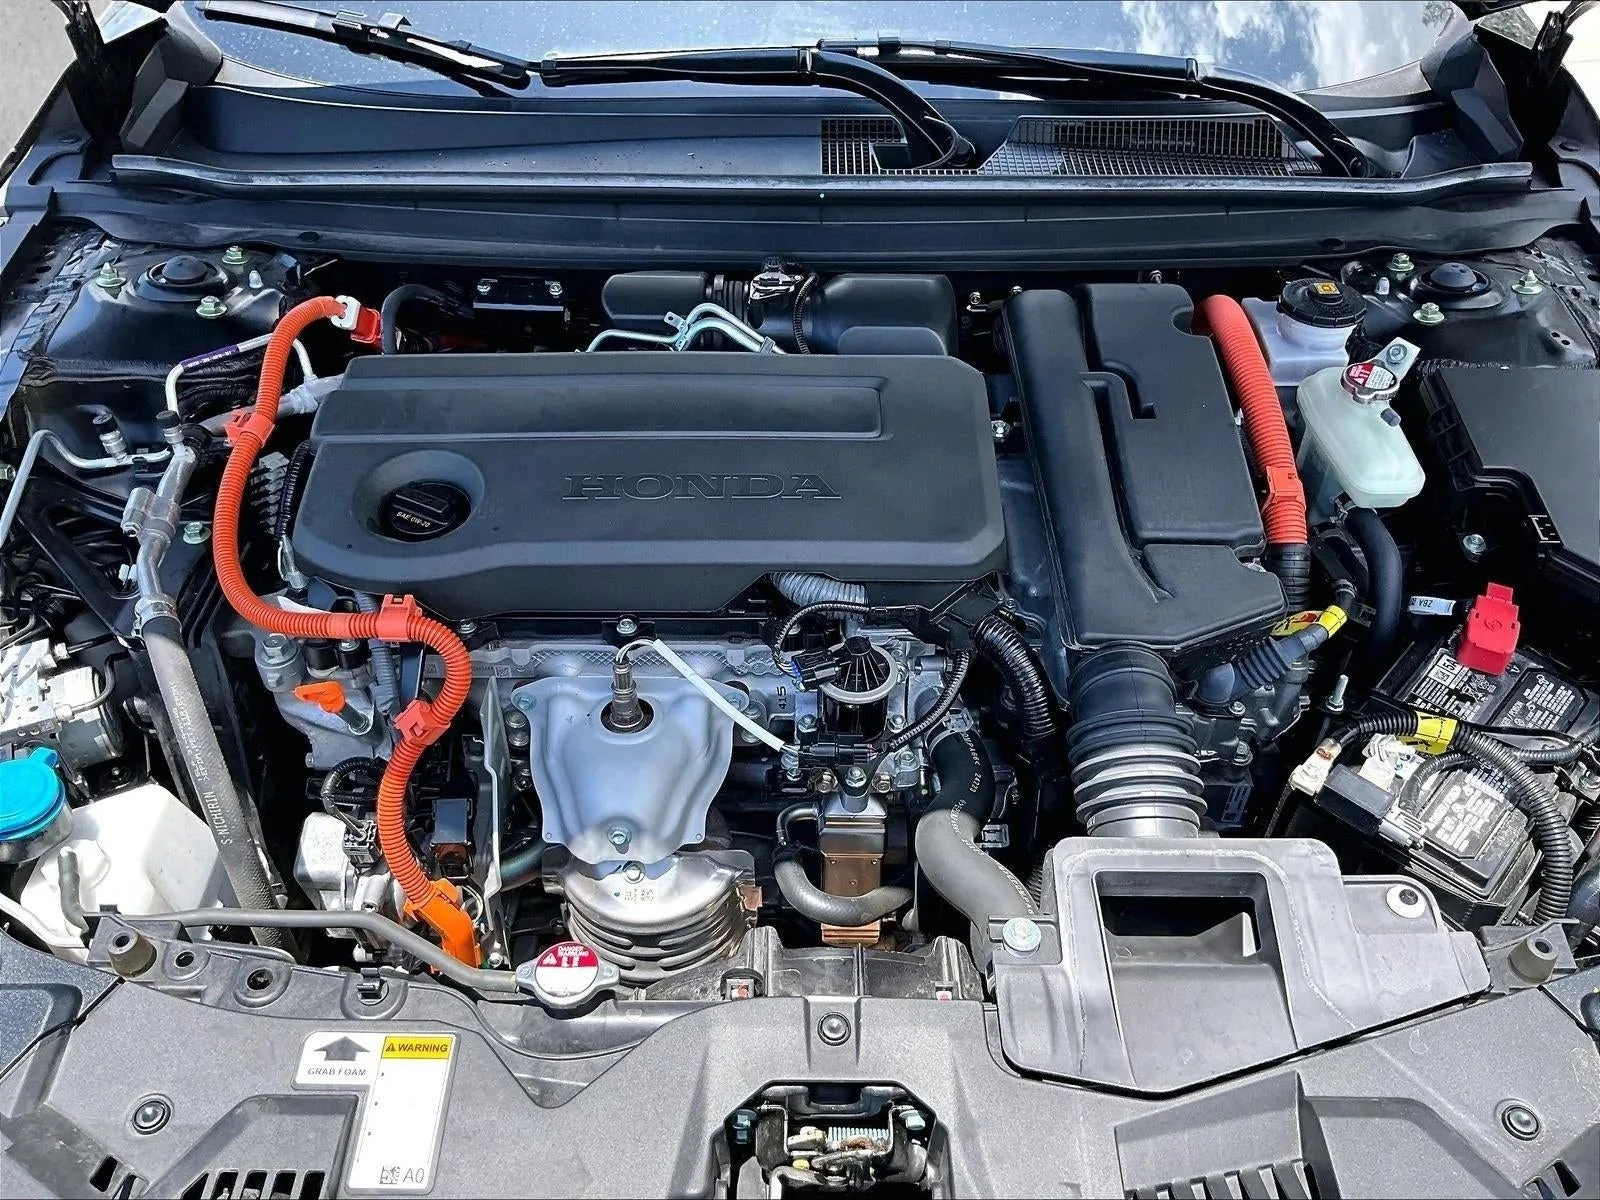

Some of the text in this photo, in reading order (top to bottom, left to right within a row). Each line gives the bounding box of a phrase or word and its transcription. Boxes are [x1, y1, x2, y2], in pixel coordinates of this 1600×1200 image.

[562, 473, 842, 500] HONDA
[396, 511, 431, 528] SAE 0W-20
[776, 686, 787, 709] 415
[398, 1043, 448, 1052] WARNING
[307, 1067, 367, 1077] GRAB FOAM
